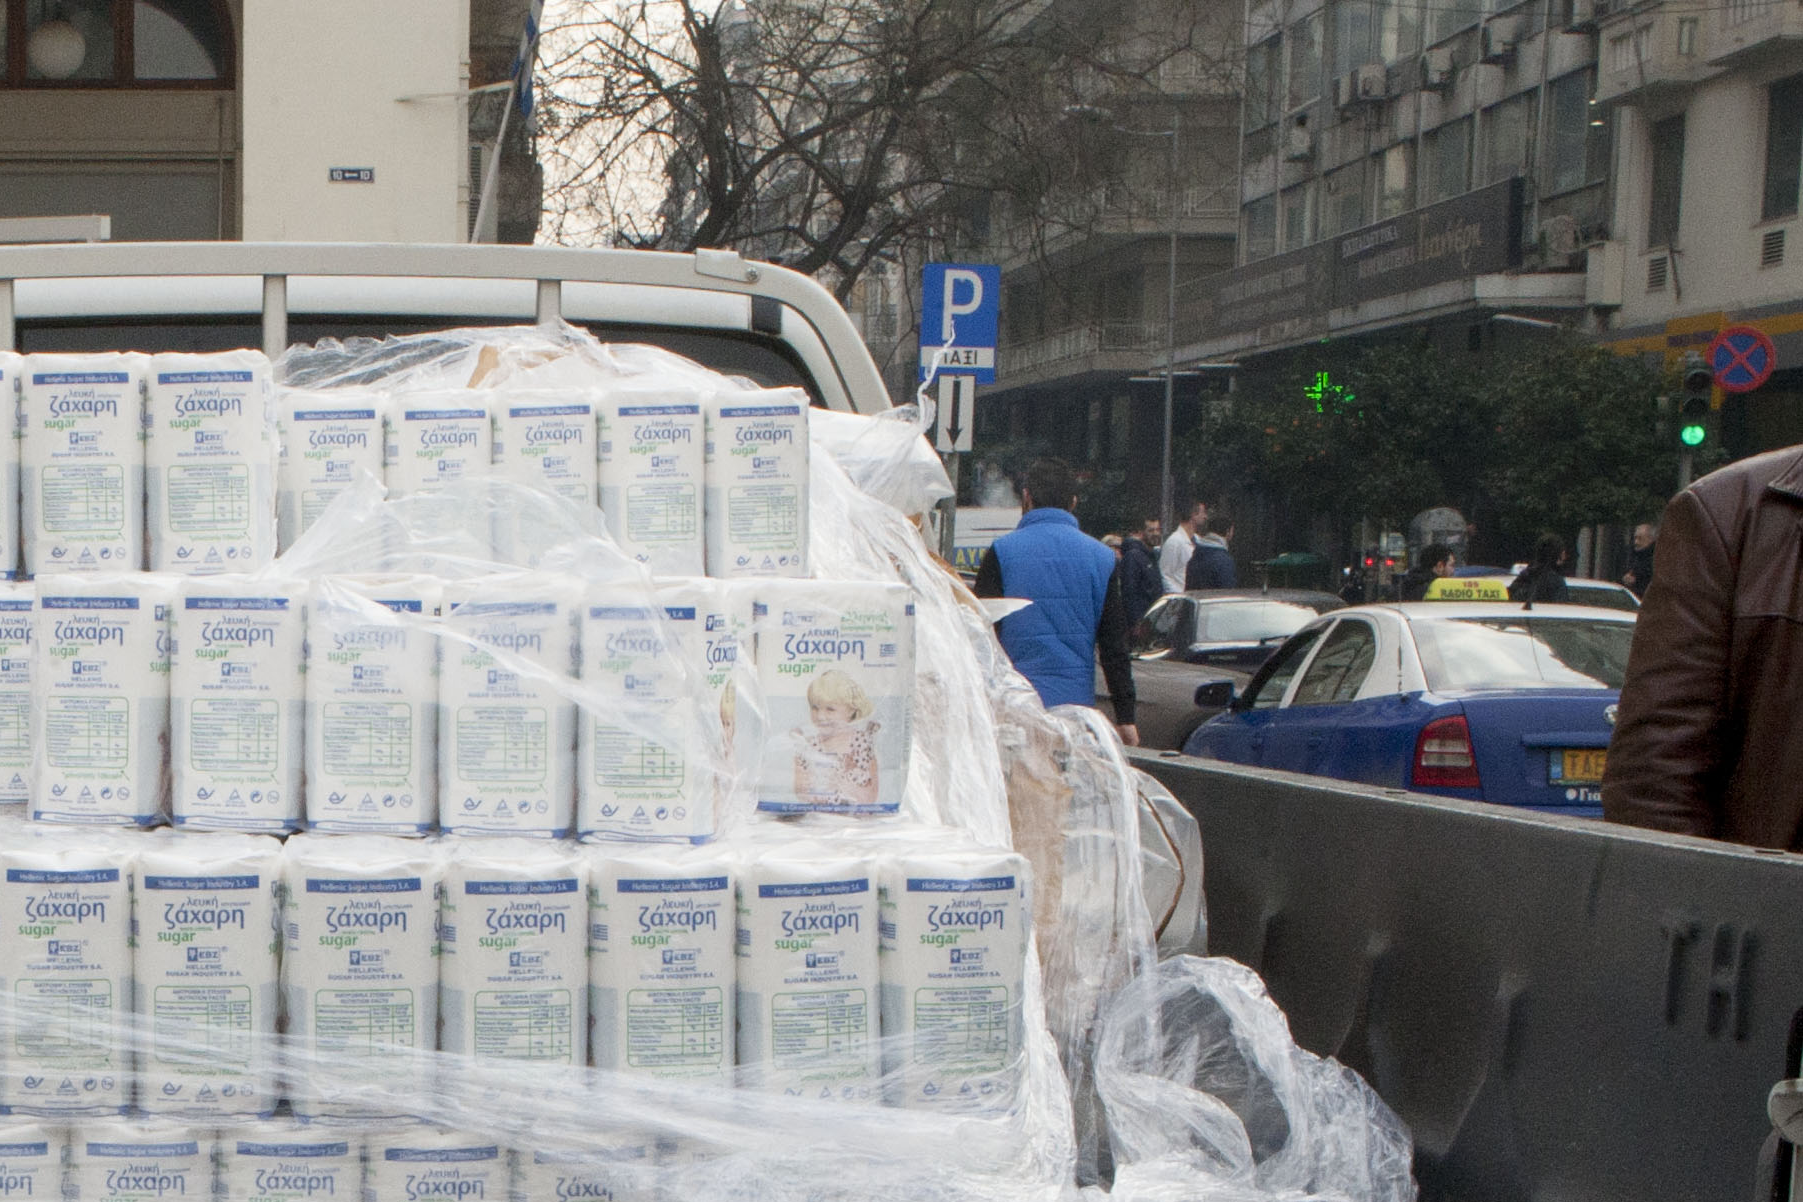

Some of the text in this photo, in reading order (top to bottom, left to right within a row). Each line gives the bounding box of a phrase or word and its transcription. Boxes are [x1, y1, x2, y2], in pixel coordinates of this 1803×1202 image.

[942, 269, 984, 340] P
[49, 395, 117, 417] ζάχαρη
[174, 395, 243, 417] ζάχαρη
[309, 427, 367, 448] ζάχαρη
[736, 424, 792, 446] ζάχαρη
[1477, 589, 1500, 598] TAXI
[55, 620, 123, 644] ζάχαρη
[202, 622, 274, 646] ζάχαρη
[195, 646, 228, 660] sugar
[783, 632, 865, 661] ζάχαρη
[777, 661, 817, 677] sugar
[25, 896, 105, 922] ζάχαρη
[164, 902, 245, 929] ζάχαρη
[327, 906, 407, 932] ζάχαρη
[486, 907, 565, 932] ζάχαρη
[639, 905, 716, 932] ζάχαρη
[927, 905, 1003, 932] ζάχαρη
[18, 923, 57, 938] sugar
[781, 908, 858, 934] ζάχαρη
[157, 929, 196, 944] sugar
[319, 933, 358, 948] sugar
[478, 934, 518, 950] sugar
[631, 933, 670, 947] sugar
[775, 937, 814, 952] sugar
[920, 932, 960, 948] sugar
